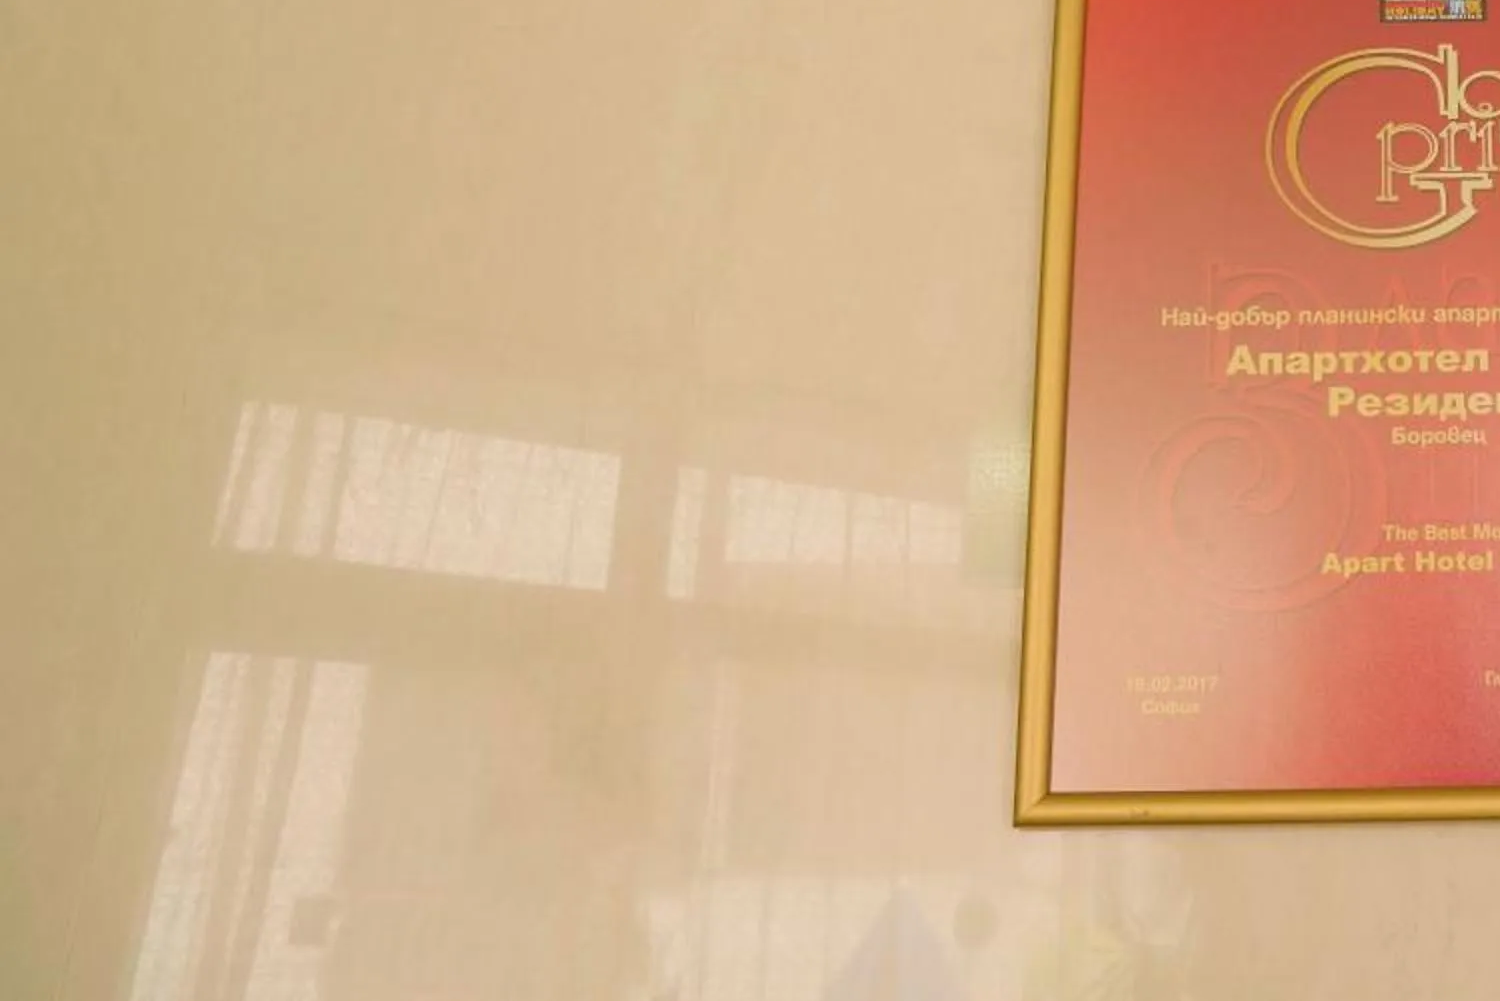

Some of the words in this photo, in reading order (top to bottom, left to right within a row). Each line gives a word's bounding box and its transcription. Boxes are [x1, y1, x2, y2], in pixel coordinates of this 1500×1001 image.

[1161, 305, 1290, 330] Най-добър
[1299, 304, 1426, 326] планински
[1226, 344, 1489, 381] Апартхотел
[1391, 426, 1487, 447] Боровец
[1383, 523, 1419, 542] The
[1424, 523, 1468, 541] Best
[1321, 551, 1404, 578] Apart
[1415, 549, 1494, 573] Hotel
